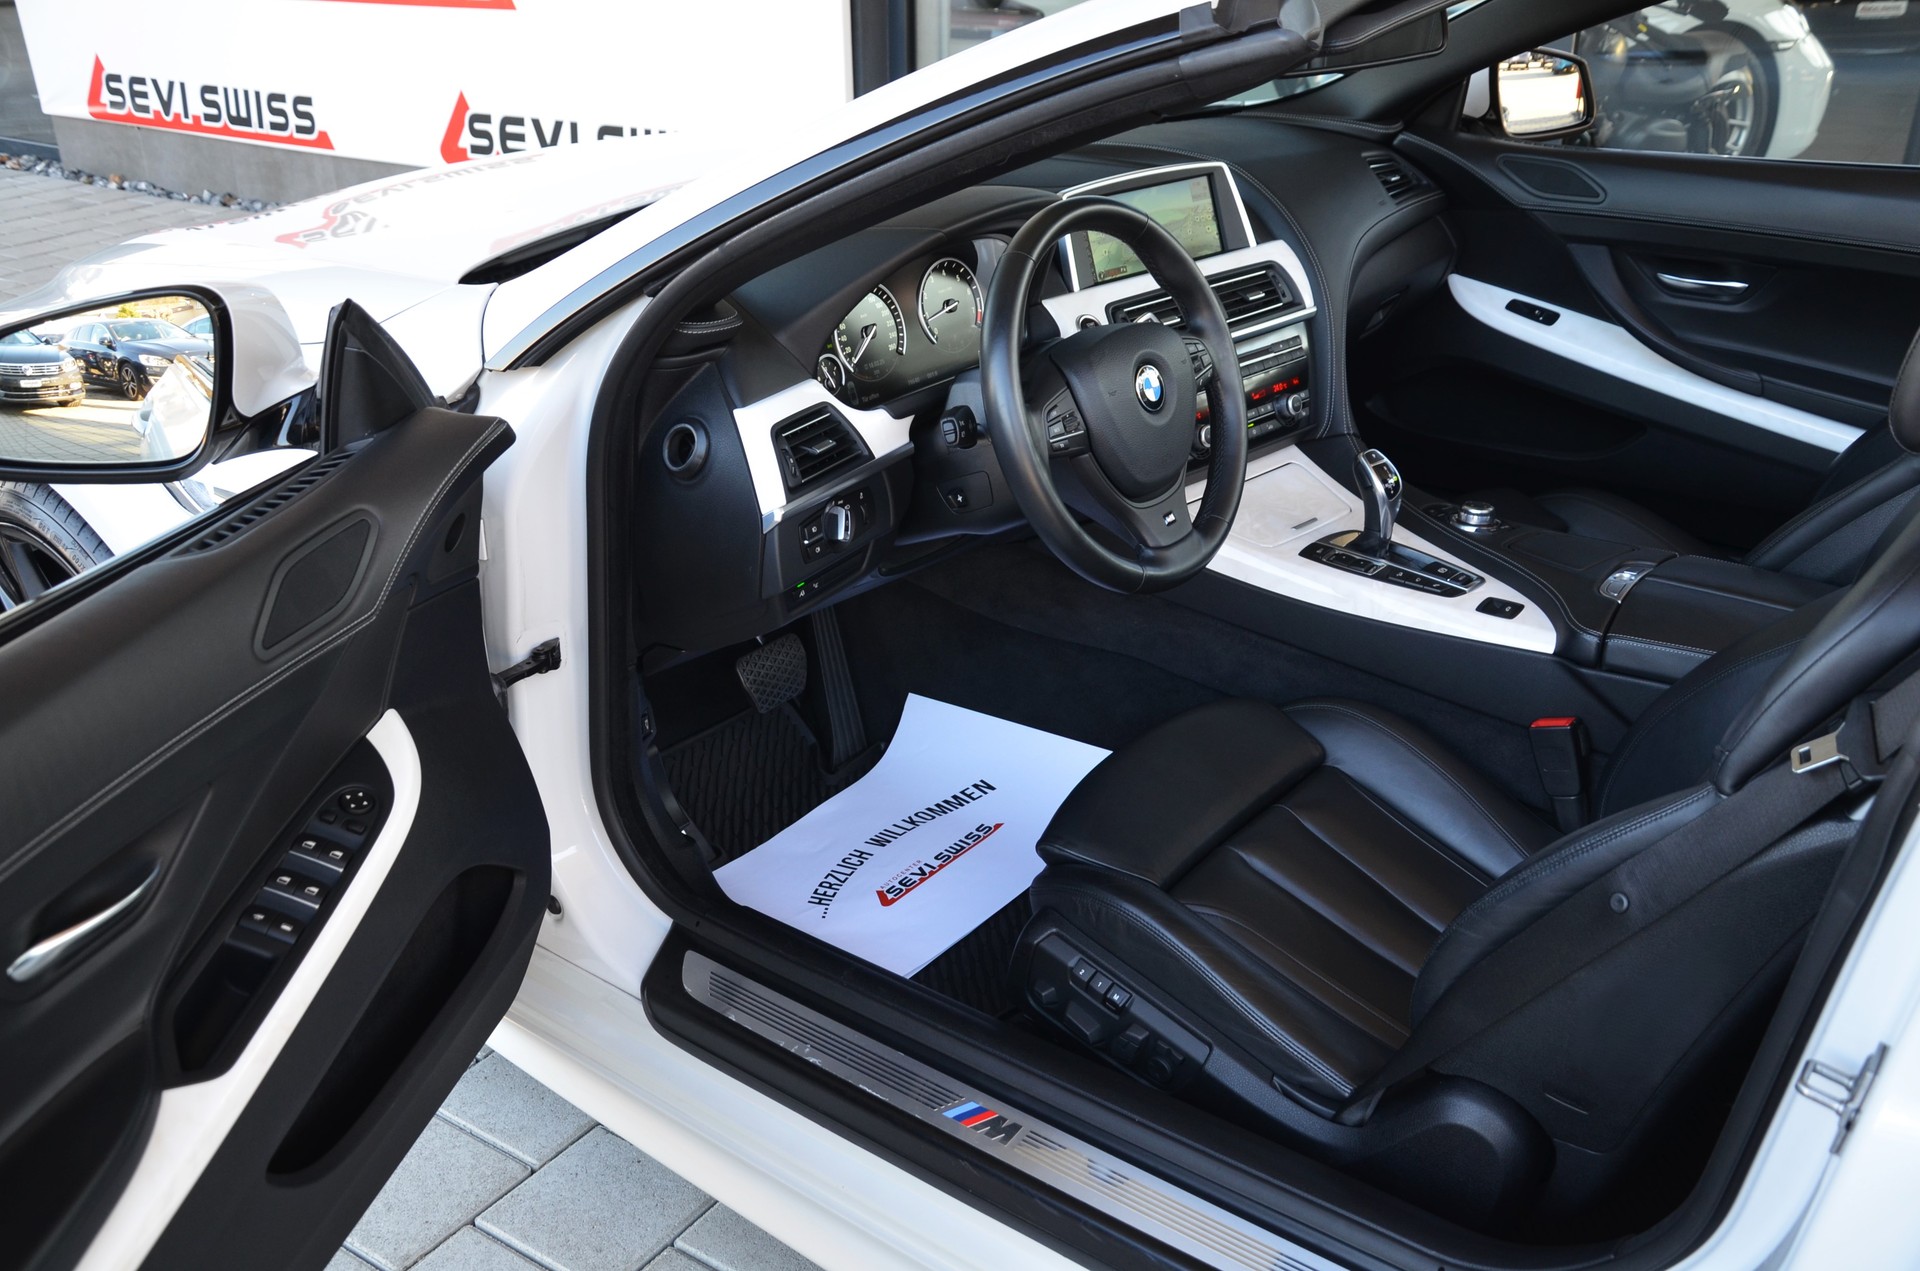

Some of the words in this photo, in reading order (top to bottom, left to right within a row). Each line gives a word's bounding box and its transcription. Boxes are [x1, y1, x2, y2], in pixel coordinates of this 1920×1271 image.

[105, 73, 190, 120] SEVI
[200, 84, 316, 135] SWISS
[864, 779, 997, 847] WILLKOMMEN
[880, 859, 923, 890] AUTOCENTER
[885, 862, 937, 897] SEVI
[933, 823, 993, 864] SWISS
